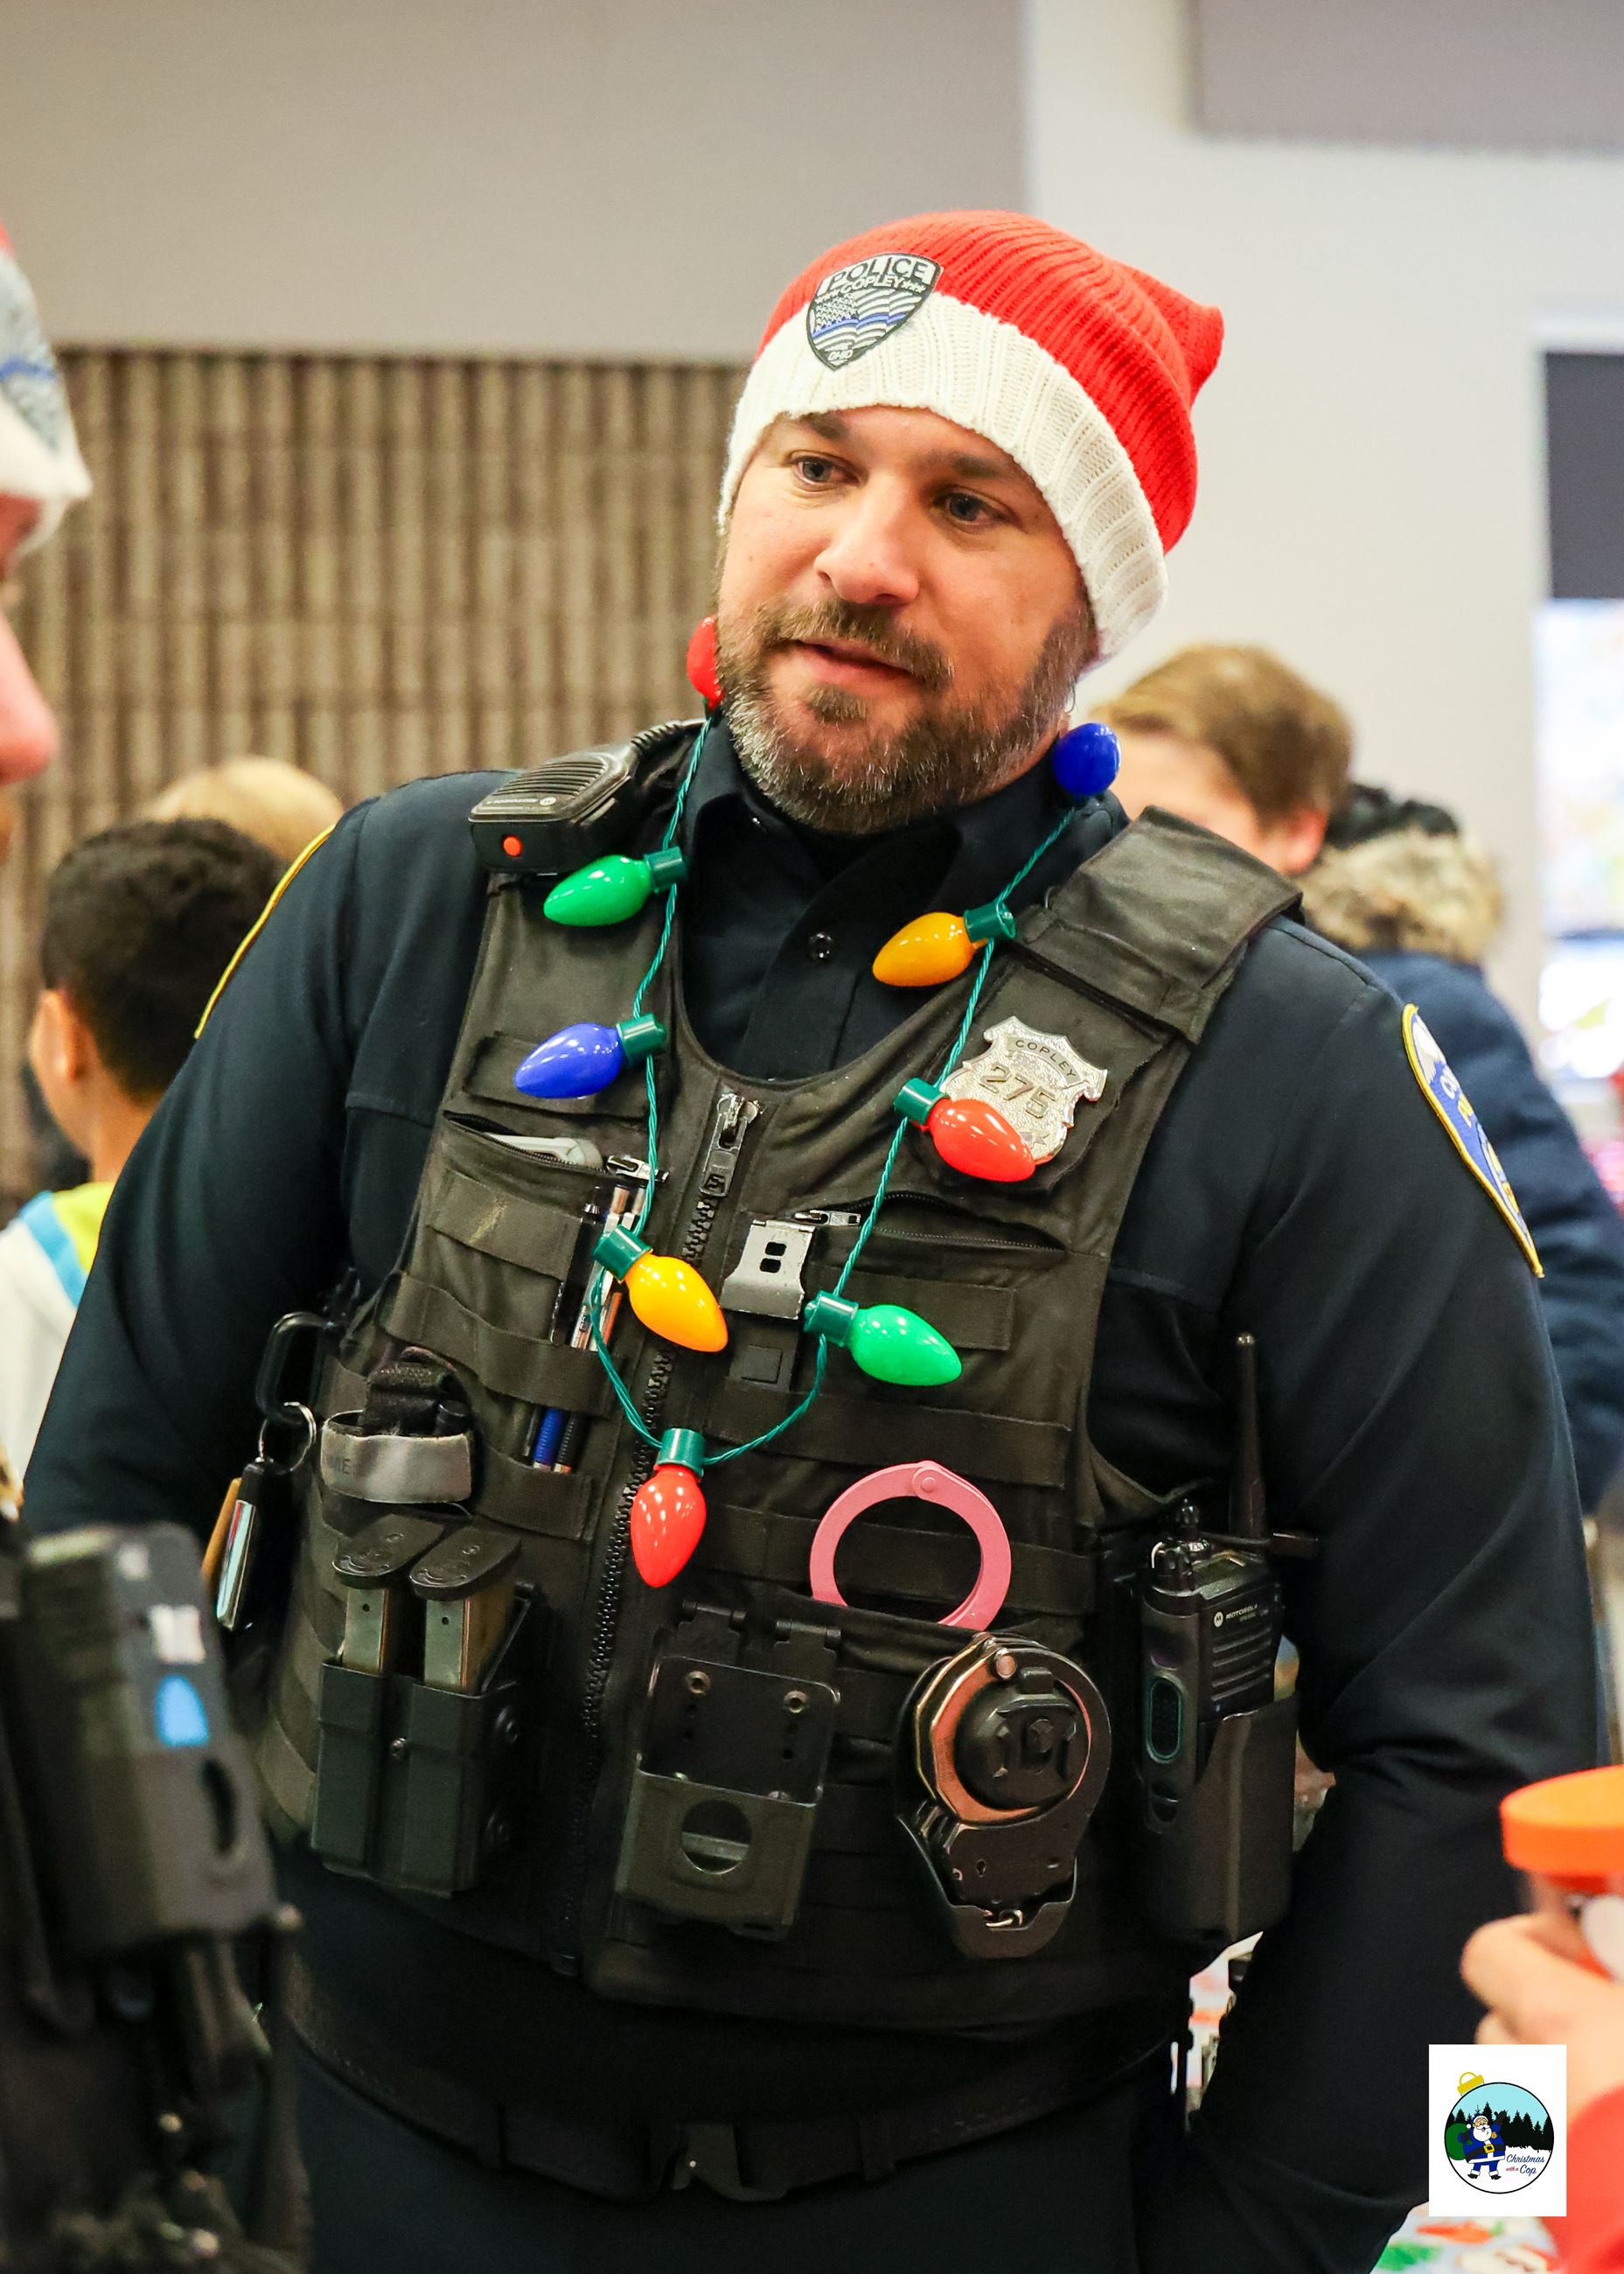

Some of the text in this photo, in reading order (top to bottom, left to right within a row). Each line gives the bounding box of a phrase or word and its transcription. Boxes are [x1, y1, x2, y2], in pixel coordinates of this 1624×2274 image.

[828, 256, 930, 291] POLICE
[840, 274, 905, 294] COPLEY
[827, 350, 854, 361] OHIO
[1015, 1039, 1077, 1078] COPLEY
[979, 1062, 1056, 1120] 275
